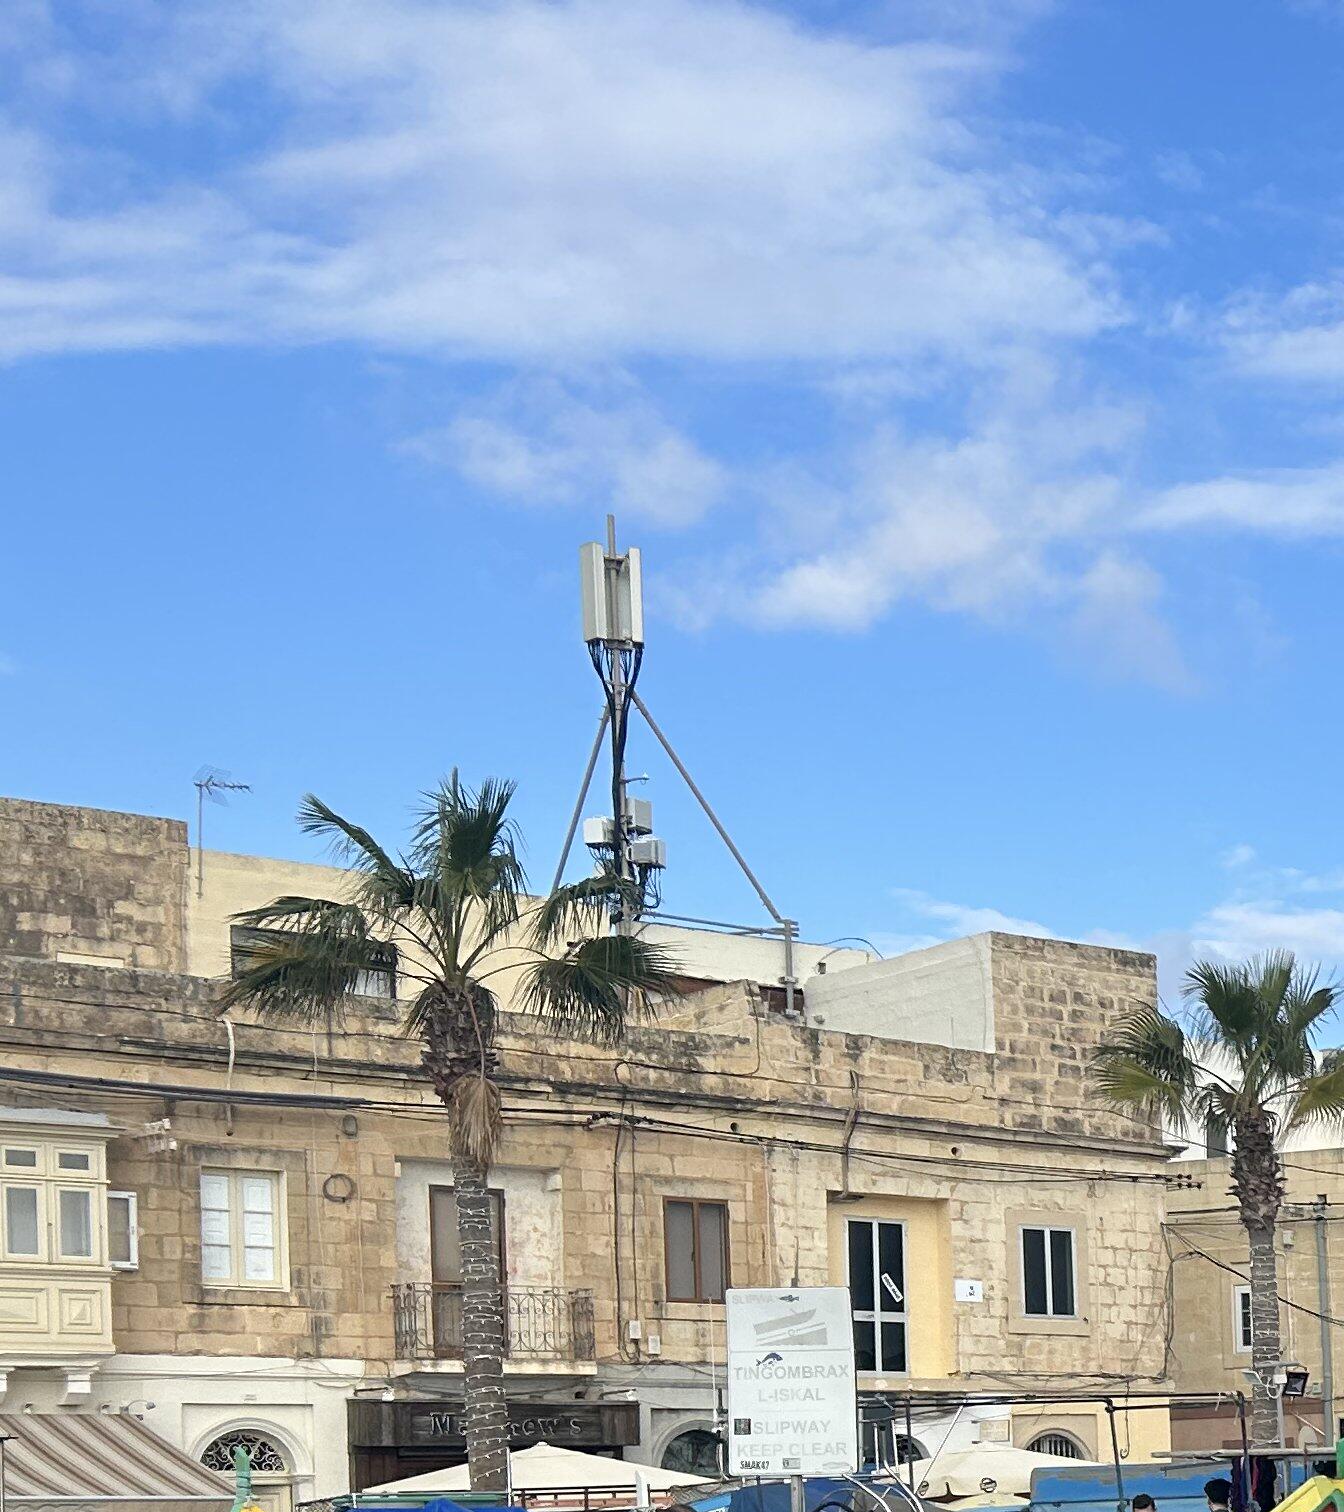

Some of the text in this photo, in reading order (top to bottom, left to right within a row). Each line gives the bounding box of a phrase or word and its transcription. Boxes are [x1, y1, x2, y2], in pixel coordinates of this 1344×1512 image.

[733, 1364, 849, 1380] TINGOMBRAX
[758, 1388, 826, 1402] L-ISKAL
[753, 1420, 831, 1435] SLIPWAY
[737, 1442, 848, 1458] KEEP CLEAR
